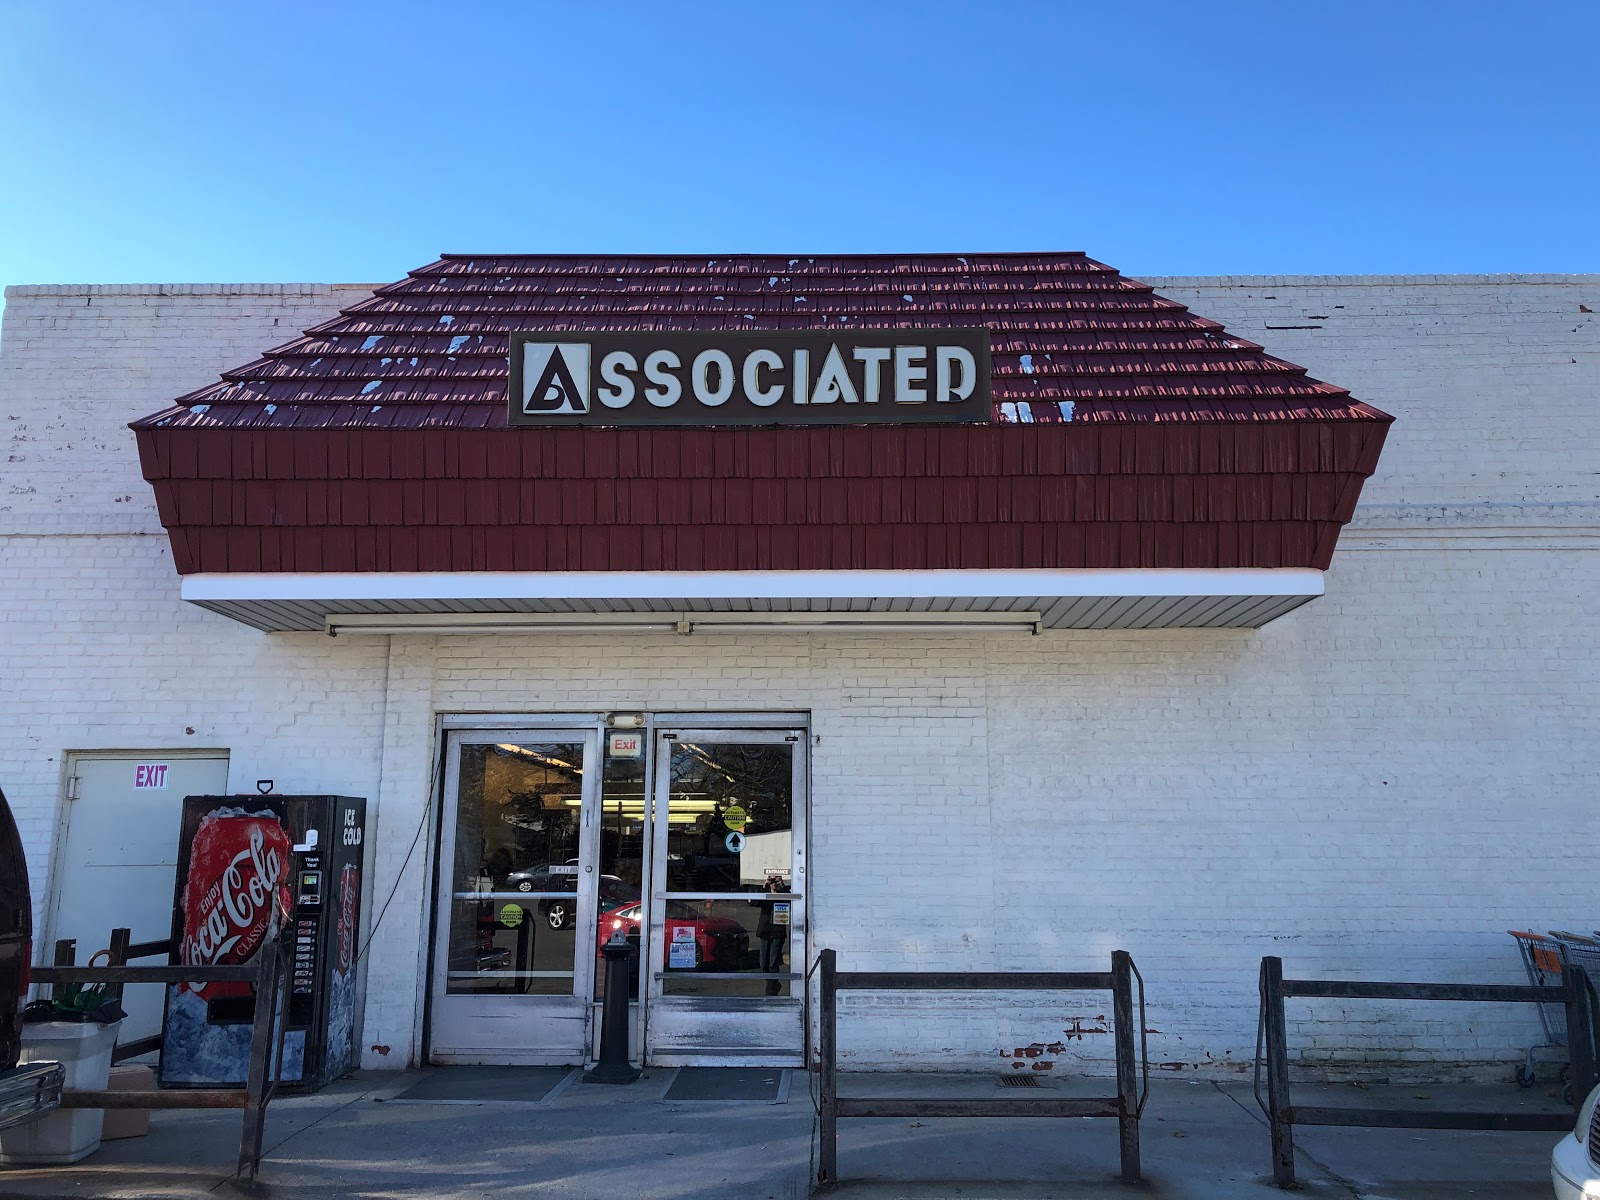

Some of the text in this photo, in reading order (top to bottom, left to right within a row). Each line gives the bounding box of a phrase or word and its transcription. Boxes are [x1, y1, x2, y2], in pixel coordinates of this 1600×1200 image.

[523, 342, 976, 413] ASSOCIATED
[615, 739, 636, 750] Exit
[136, 765, 167, 787] EXIT
[344, 808, 356, 826] ICE
[343, 827, 361, 846] COLD
[200, 881, 221, 915] Enjoy
[236, 917, 269, 957] CLASSIC
